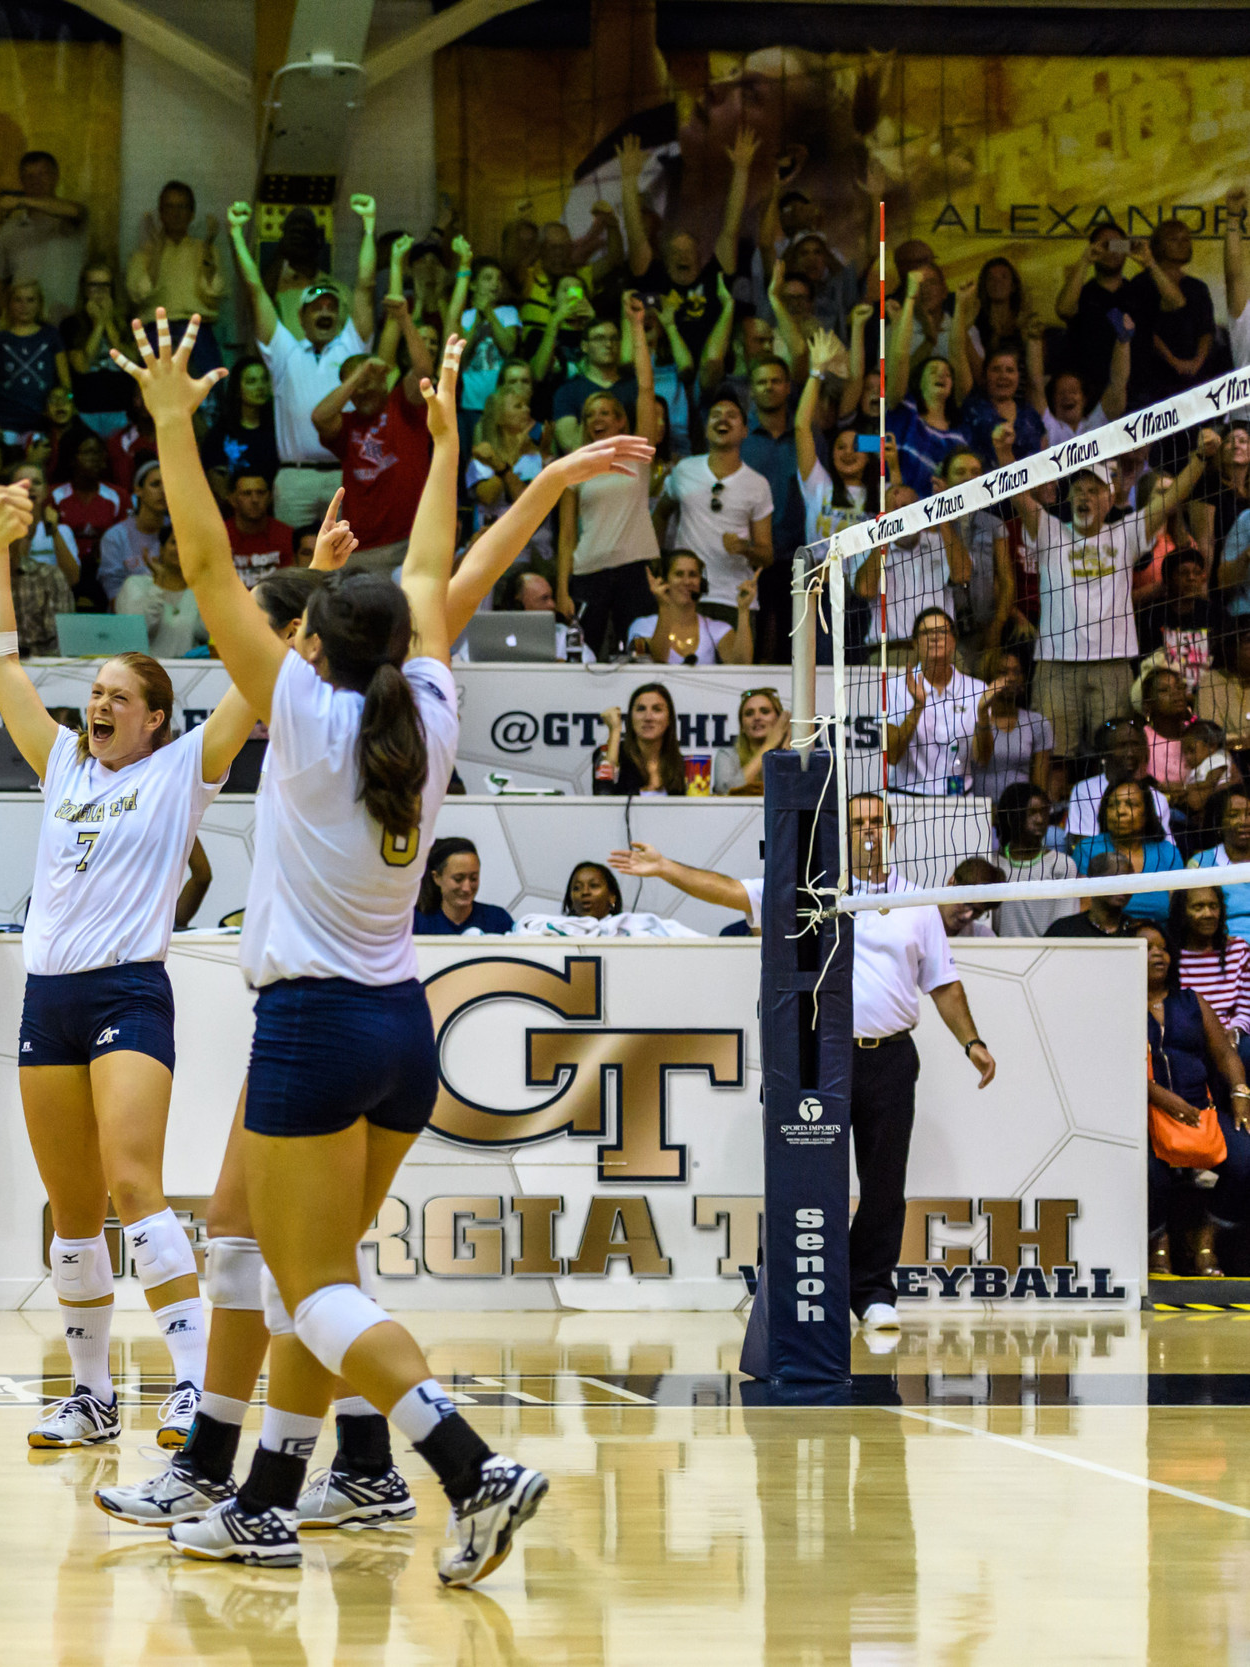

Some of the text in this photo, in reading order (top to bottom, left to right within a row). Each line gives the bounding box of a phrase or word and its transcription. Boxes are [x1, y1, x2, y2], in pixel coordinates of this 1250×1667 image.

[75, 831, 100, 873] 7
[423, 956, 744, 1182] GT
[780, 1124, 842, 1134] SPORTS IMPORTS
[692, 1197, 1081, 1281] TCH
[738, 1264, 1126, 1300] VEYBALL
